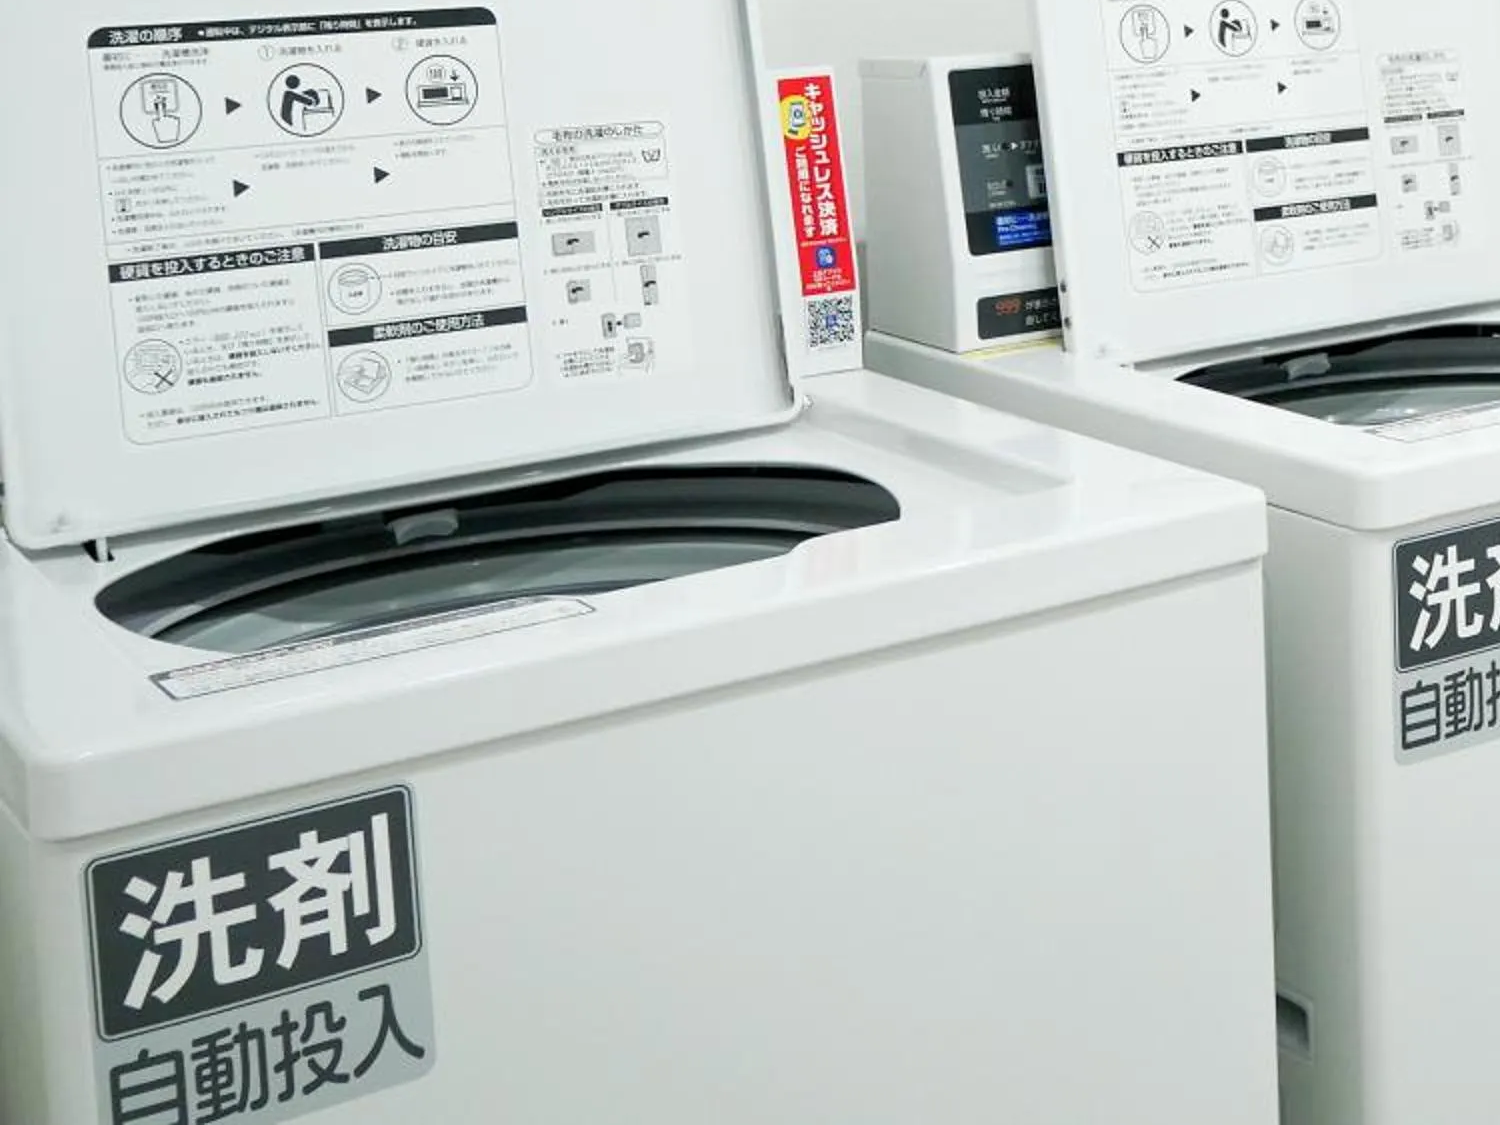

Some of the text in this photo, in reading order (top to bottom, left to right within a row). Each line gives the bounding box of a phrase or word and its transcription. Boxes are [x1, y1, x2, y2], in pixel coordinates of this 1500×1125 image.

[119, 813, 397, 1010] 洗剤
[109, 983, 425, 1125] 自動投入
